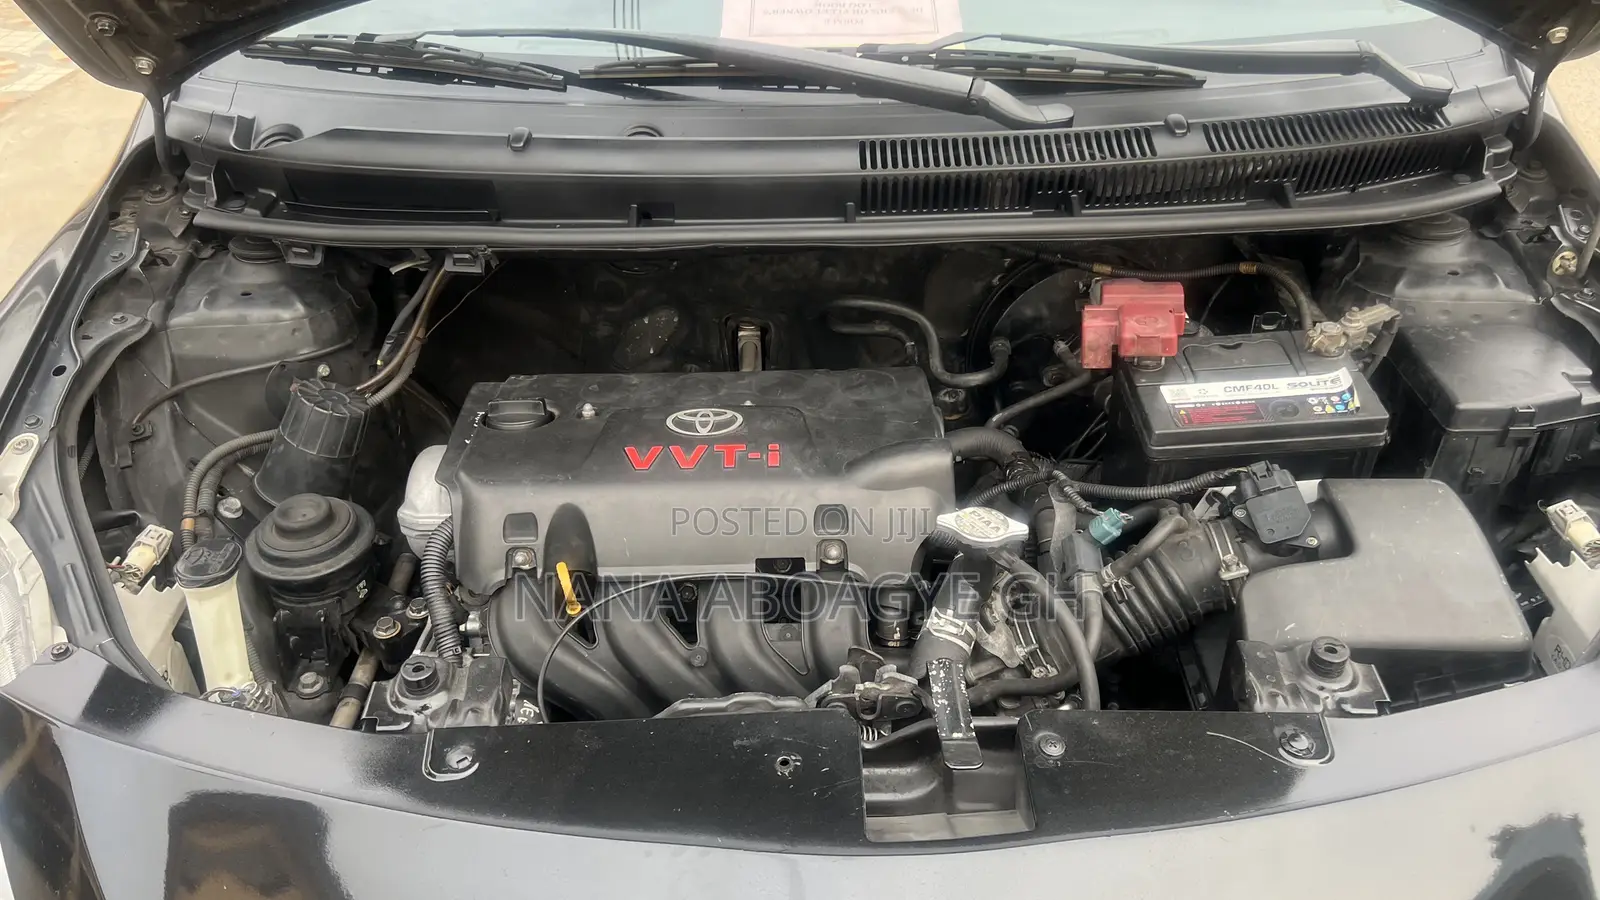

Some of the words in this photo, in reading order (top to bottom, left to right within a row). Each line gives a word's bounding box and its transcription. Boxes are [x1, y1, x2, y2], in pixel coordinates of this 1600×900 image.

[1223, 383, 1279, 394] CMF40L
[624, 443, 781, 471] VVT-i
[969, 510, 1001, 534] PIAA
